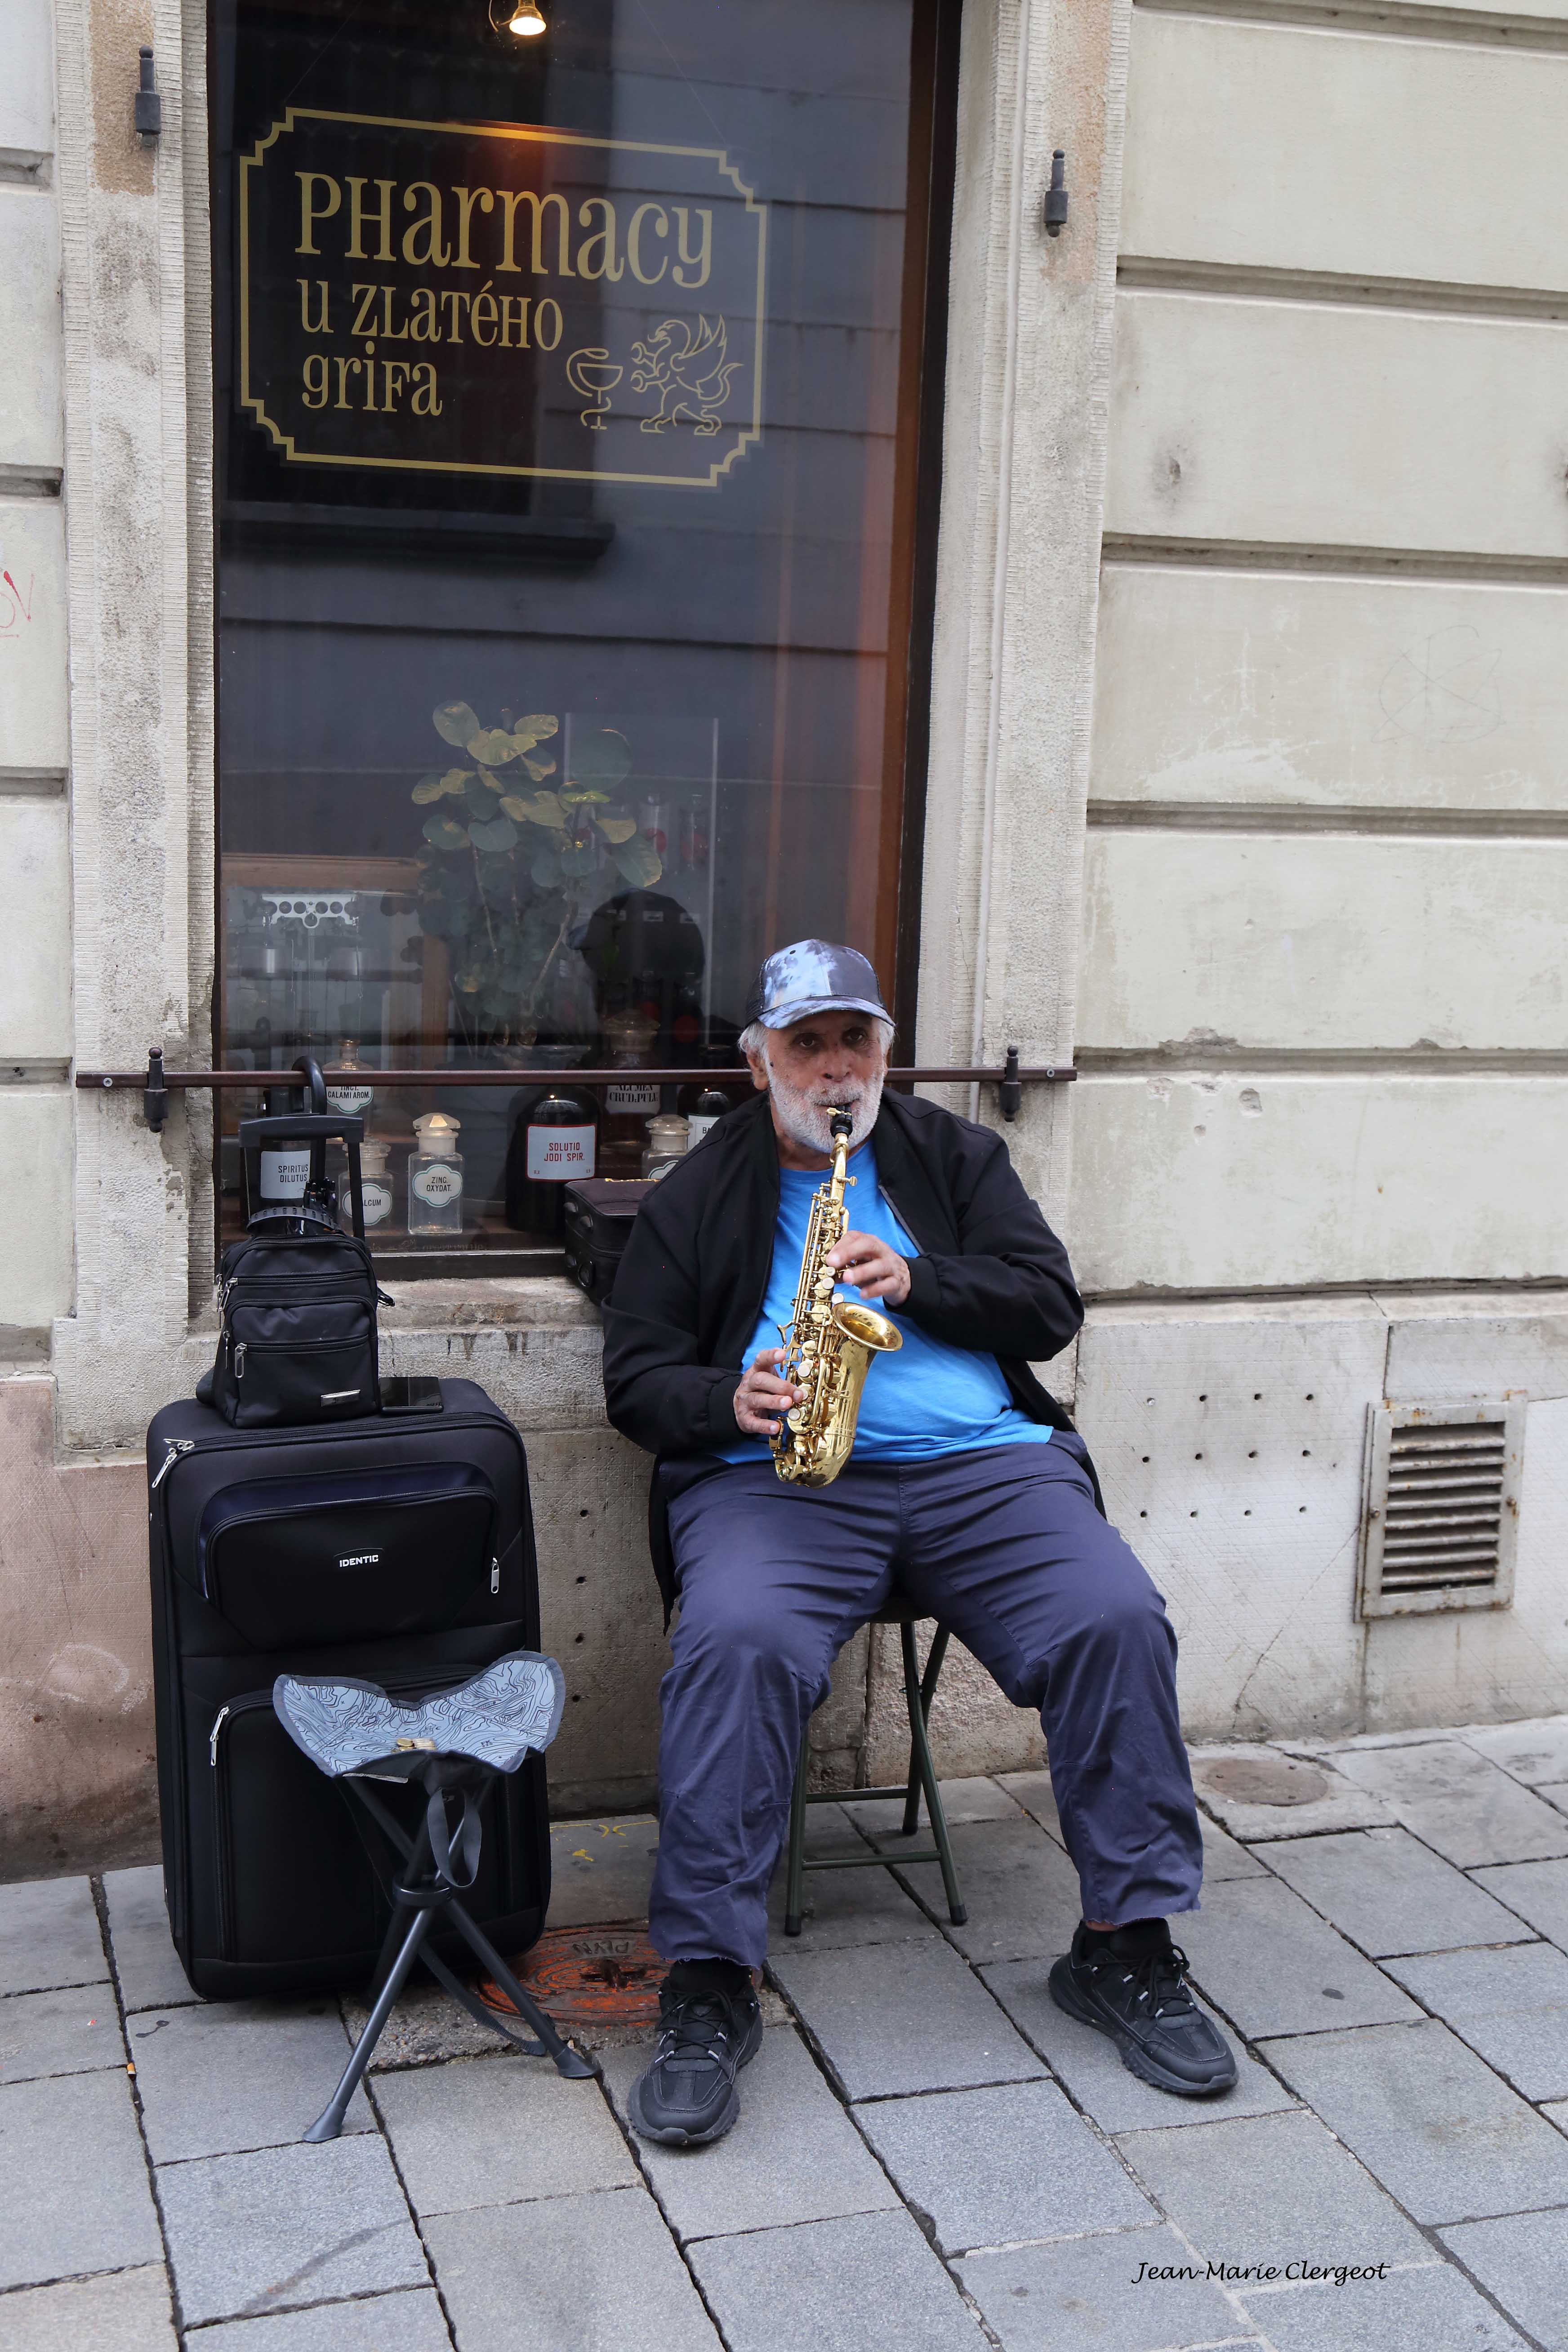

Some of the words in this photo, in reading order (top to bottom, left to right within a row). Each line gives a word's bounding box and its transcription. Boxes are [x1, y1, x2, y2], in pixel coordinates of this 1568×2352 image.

[549, 1142, 580, 1151] SOLUTIO
[544, 1153, 561, 1161] JODI
[567, 1152, 585, 1161] SPIR.
[278, 1164, 308, 1173] SPIRITUS
[280, 1174, 307, 1183] DILUTUS
[339, 1555, 379, 1567] IDENTIC
